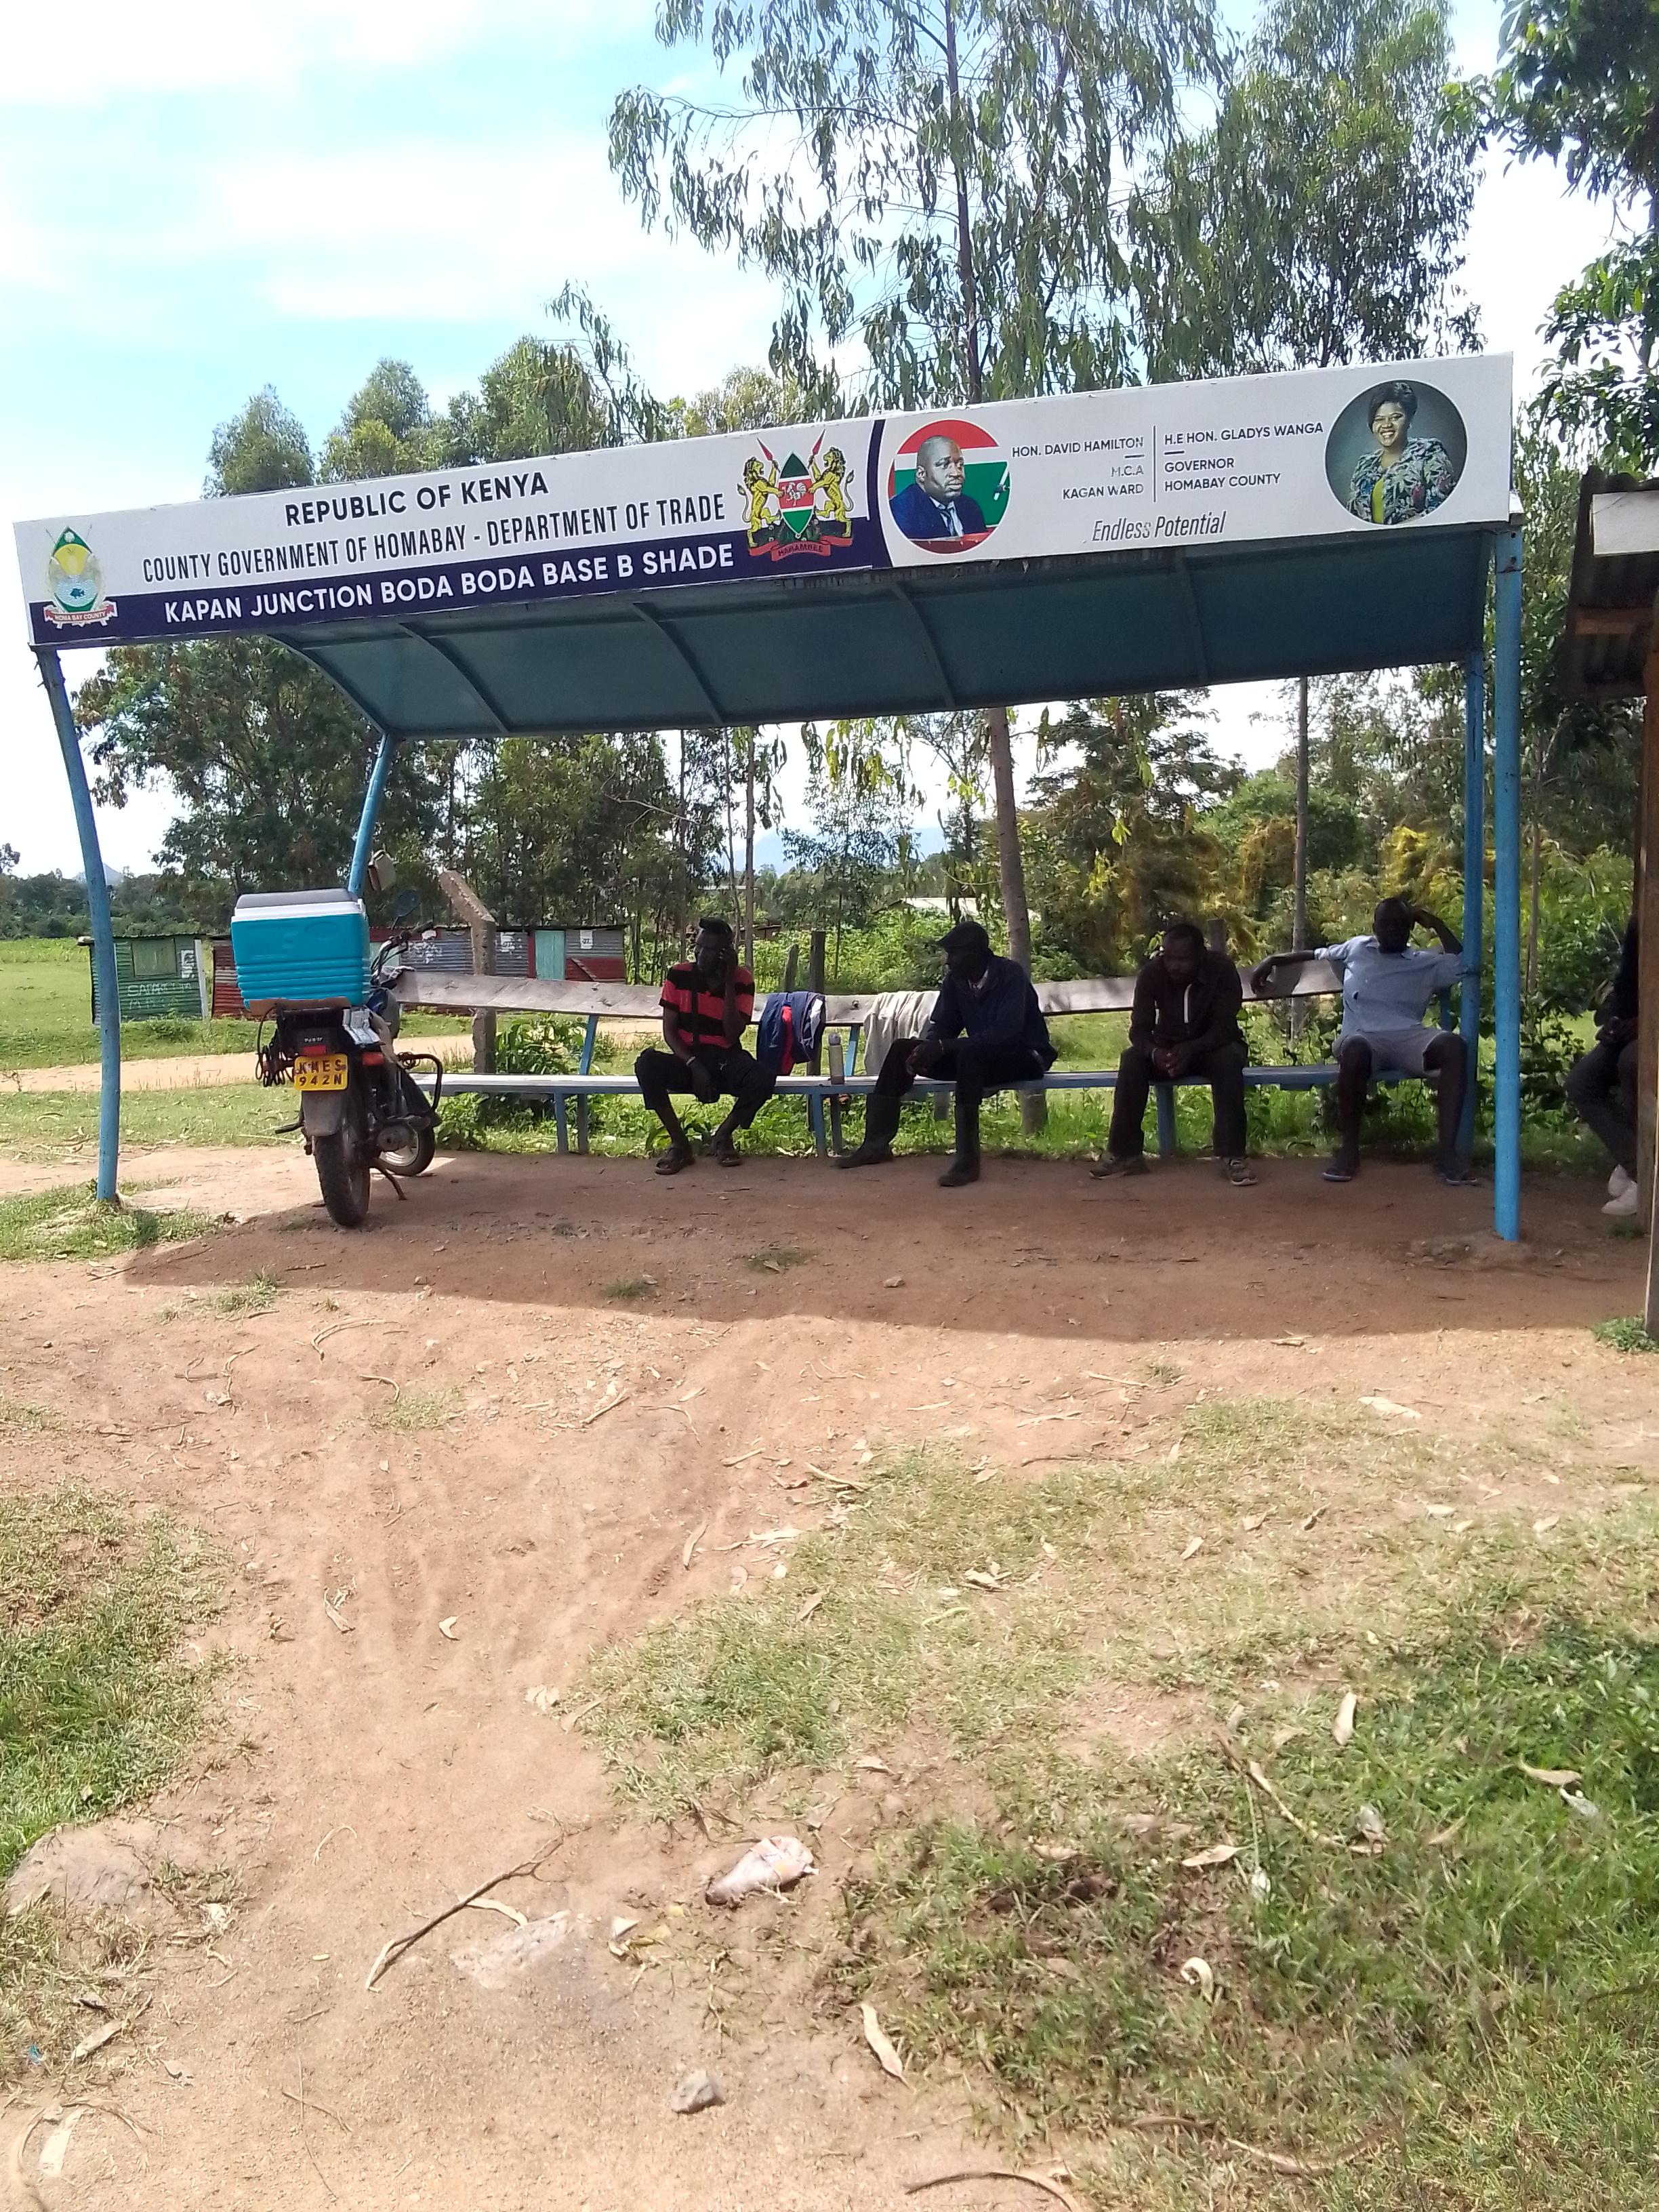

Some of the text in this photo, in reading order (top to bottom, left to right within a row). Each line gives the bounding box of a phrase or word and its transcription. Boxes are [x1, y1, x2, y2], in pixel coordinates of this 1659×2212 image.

[1164, 422, 1324, 445] H.E HON. GLADYS WANGA
[1012, 436, 1144, 457] HON. DAVID HAMILTON
[1111, 464, 1144, 477] M.C.A
[1164, 457, 1235, 474] GOVERNOR
[1063, 483, 1144, 499] KAGAN WARD
[1164, 474, 1281, 492] HOMABAY COUNTY
[285, 472, 548, 526] REPUBLIC OF KENYA
[1092, 510, 1227, 541] Endless Potential
[142, 553, 211, 582] COUNTY
[218, 540, 340, 576] GOVERNMENT
[346, 537, 369, 564] OF
[374, 525, 466, 560] HOMABAY
[487, 505, 618, 547] DEPARTMENT
[626, 503, 651, 530] OF
[657, 493, 725, 525] TRADE
[164, 543, 734, 623] KAPAN JUNCTION BODA BODA BASE B SHADE
[299, 1074, 342, 1086] 942N
